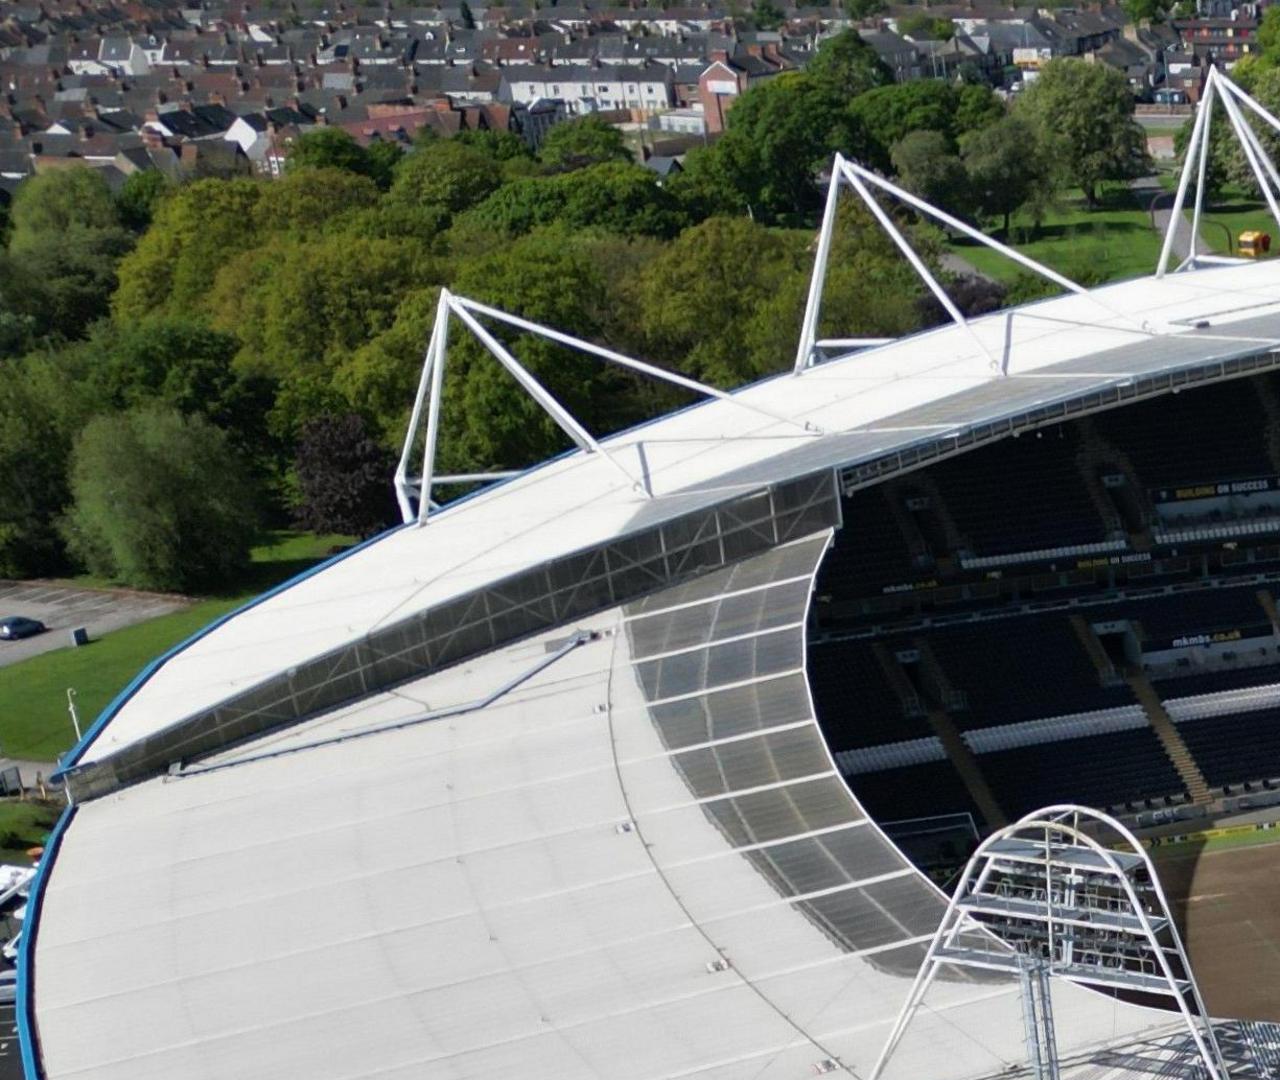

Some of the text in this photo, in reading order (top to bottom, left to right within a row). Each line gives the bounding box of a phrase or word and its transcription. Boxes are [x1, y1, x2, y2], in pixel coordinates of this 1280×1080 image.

[1217, 483, 1230, 494] ON
[1231, 480, 1269, 493] SUCCESS
[1172, 629, 1241, 647] mkmbs.co.uk
